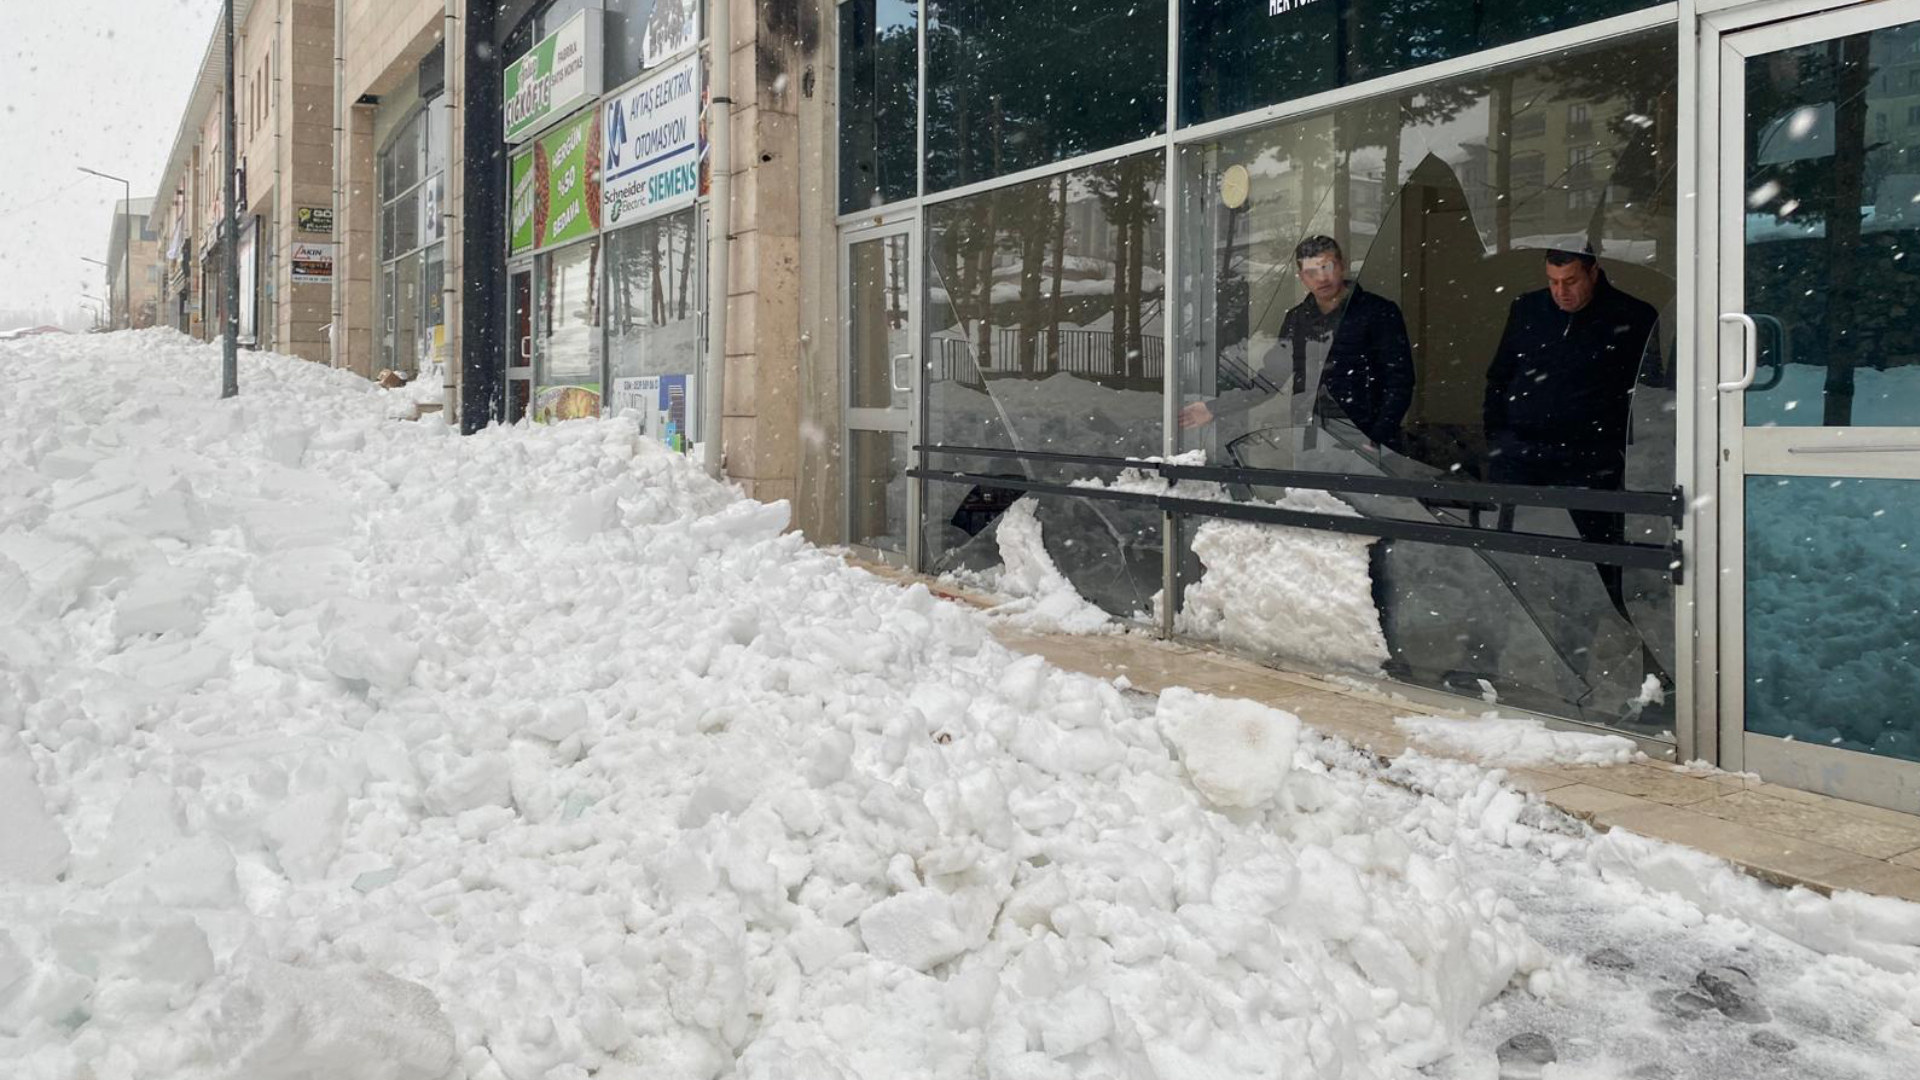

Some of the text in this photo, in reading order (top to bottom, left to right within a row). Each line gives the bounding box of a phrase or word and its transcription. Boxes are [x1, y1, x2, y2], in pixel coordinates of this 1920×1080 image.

[630, 65, 693, 121] AYTAŞ ELEKTRİK
[635, 116, 687, 160] OTOMASYON
[604, 161, 696, 204] Schneider SIEMENS
[552, 198, 580, 238] BEDAVA
